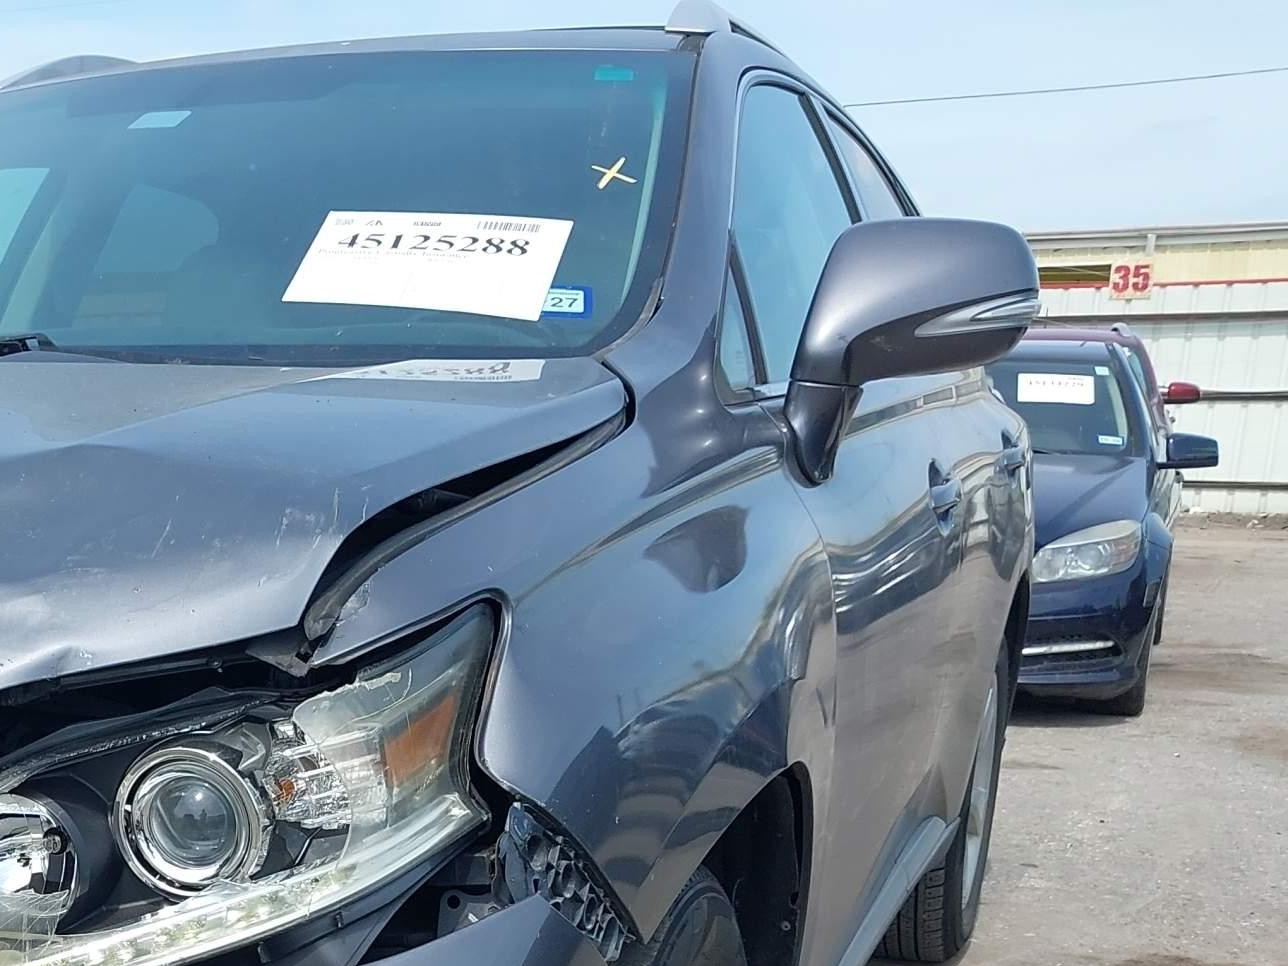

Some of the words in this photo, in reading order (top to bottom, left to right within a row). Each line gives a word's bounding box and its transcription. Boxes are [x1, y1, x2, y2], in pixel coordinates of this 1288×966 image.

[338, 233, 531, 256] 45125288
[1112, 264, 1150, 294] 35
[550, 296, 578, 308] 27
